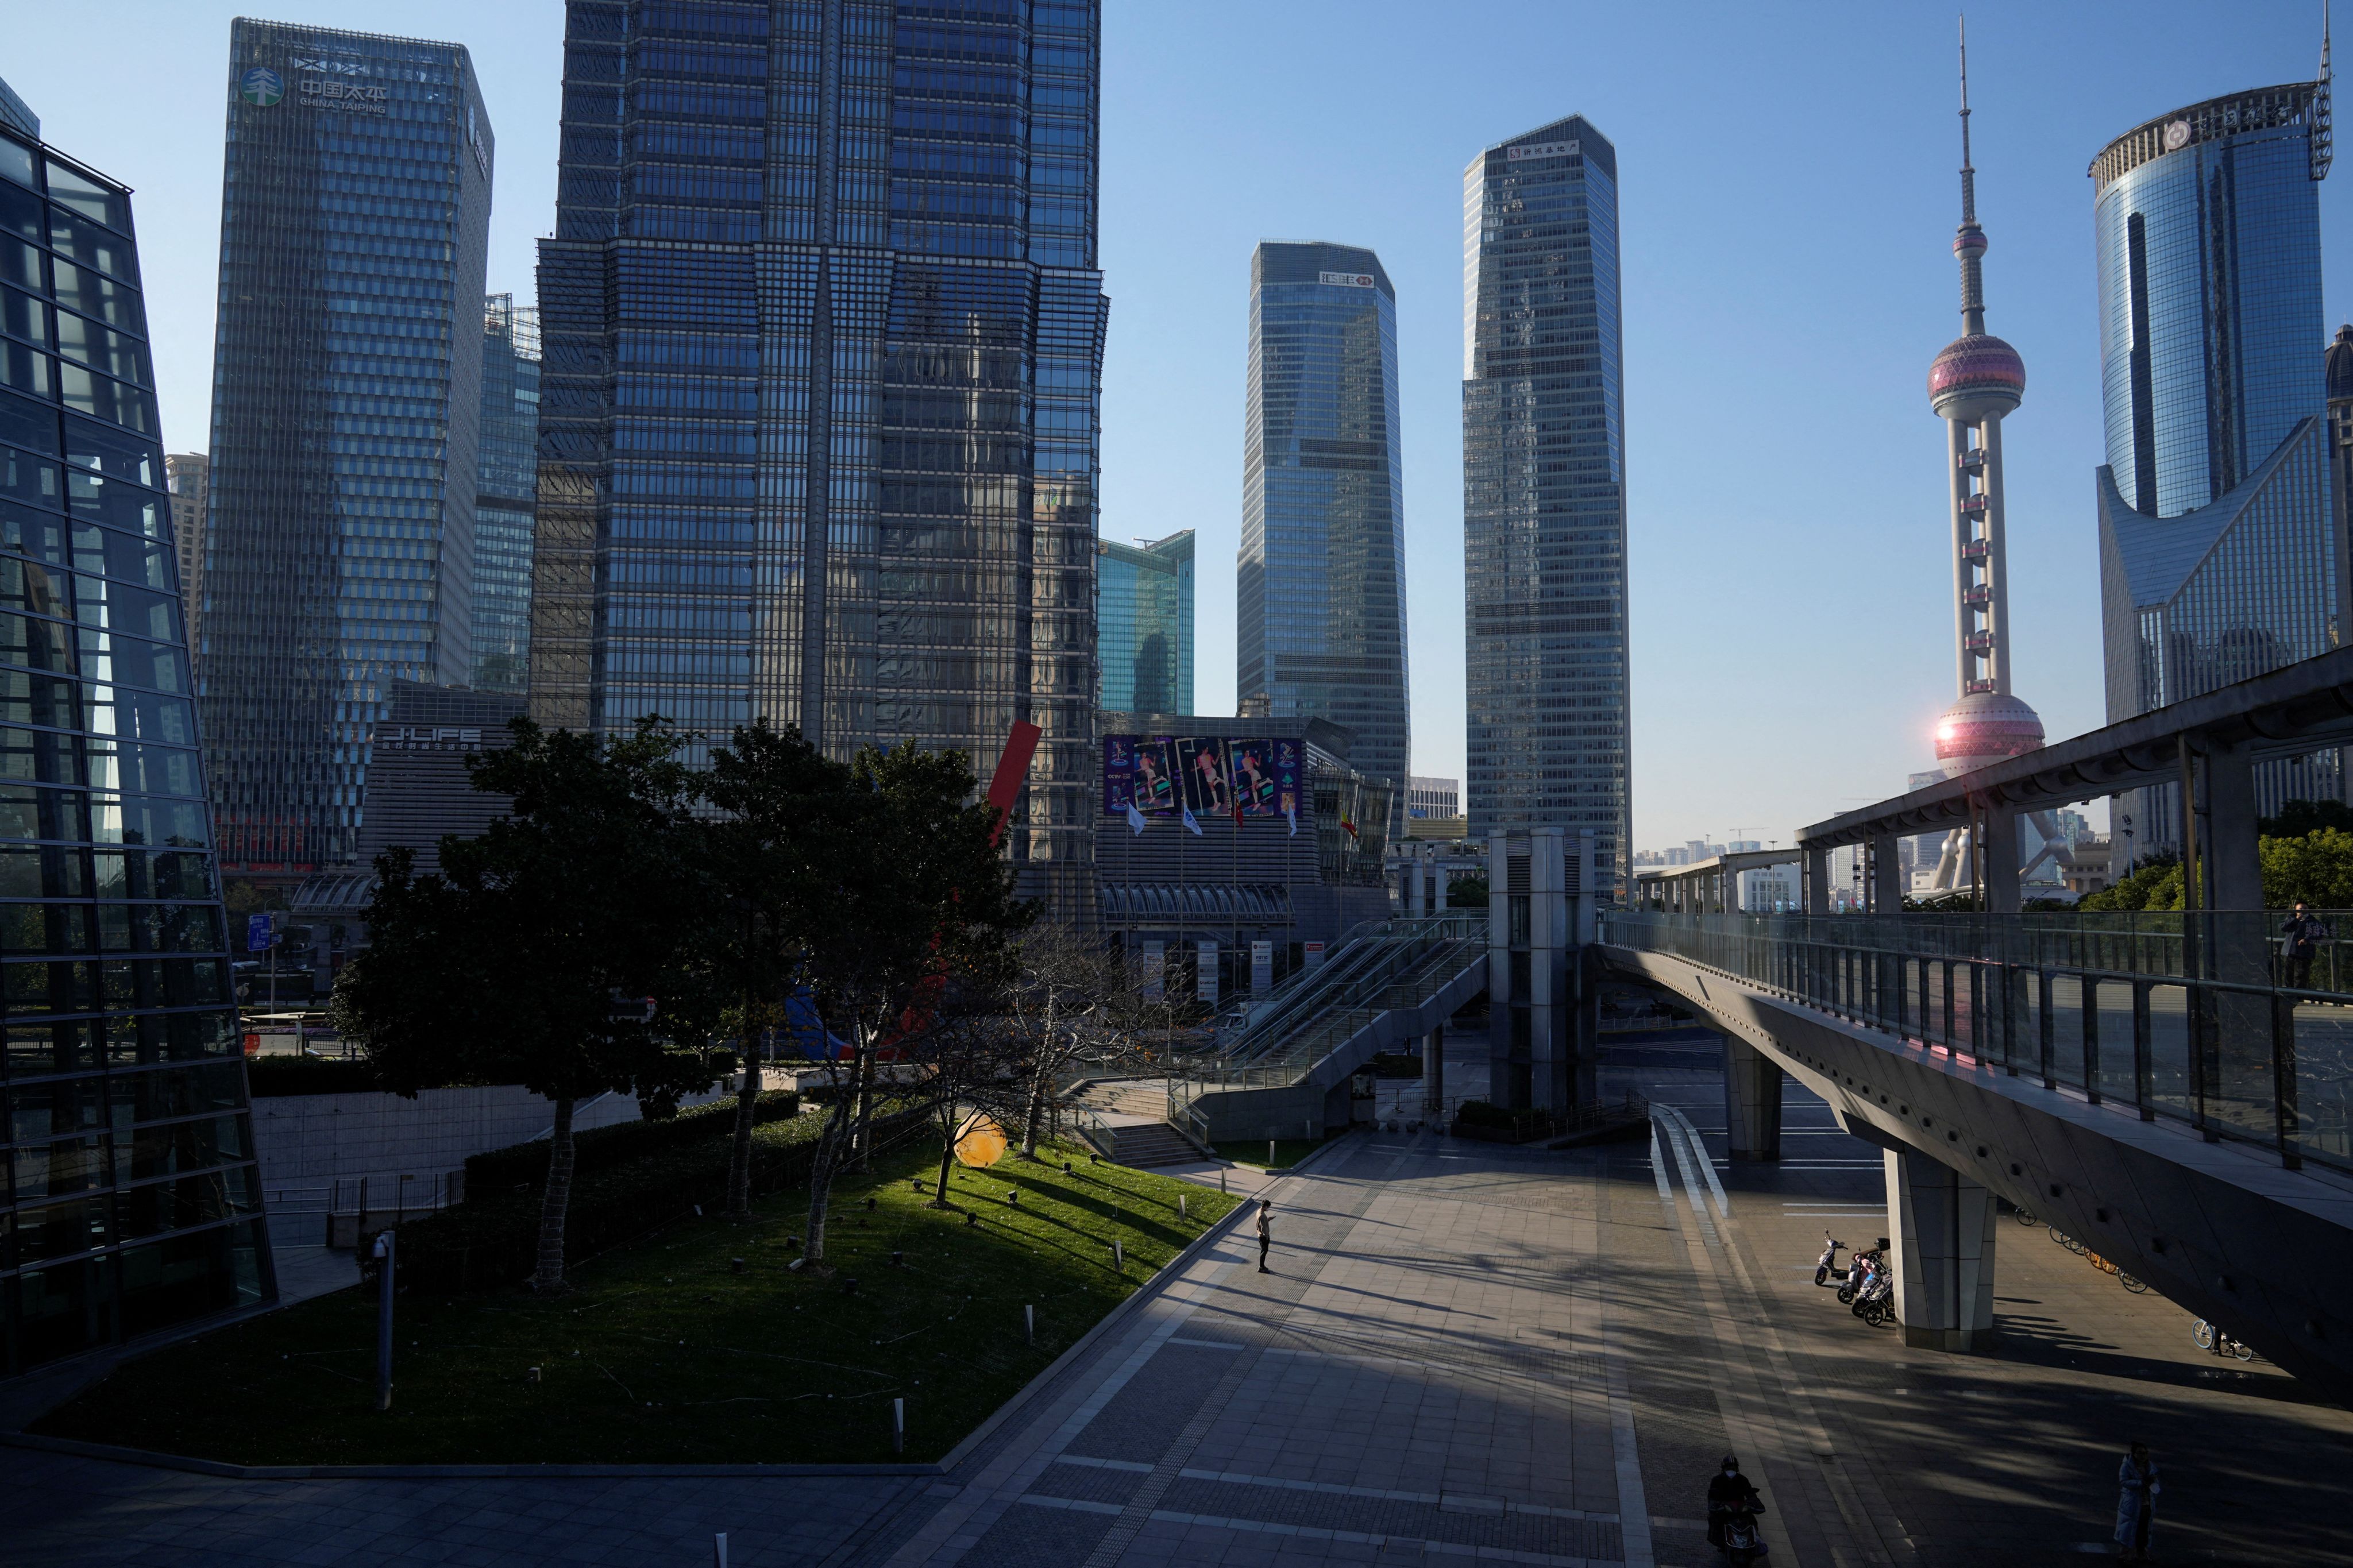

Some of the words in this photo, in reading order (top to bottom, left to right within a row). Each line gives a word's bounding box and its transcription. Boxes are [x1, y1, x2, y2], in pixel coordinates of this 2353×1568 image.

[300, 79, 387, 102] 中国太平
[300, 98, 335, 109] CHINA
[341, 102, 385, 114] TAIPING
[2200, 101, 2294, 136] 中国银行
[1523, 143, 1576, 156] 新鸿基地产
[382, 741, 481, 751] 金茂时尚生活中心
